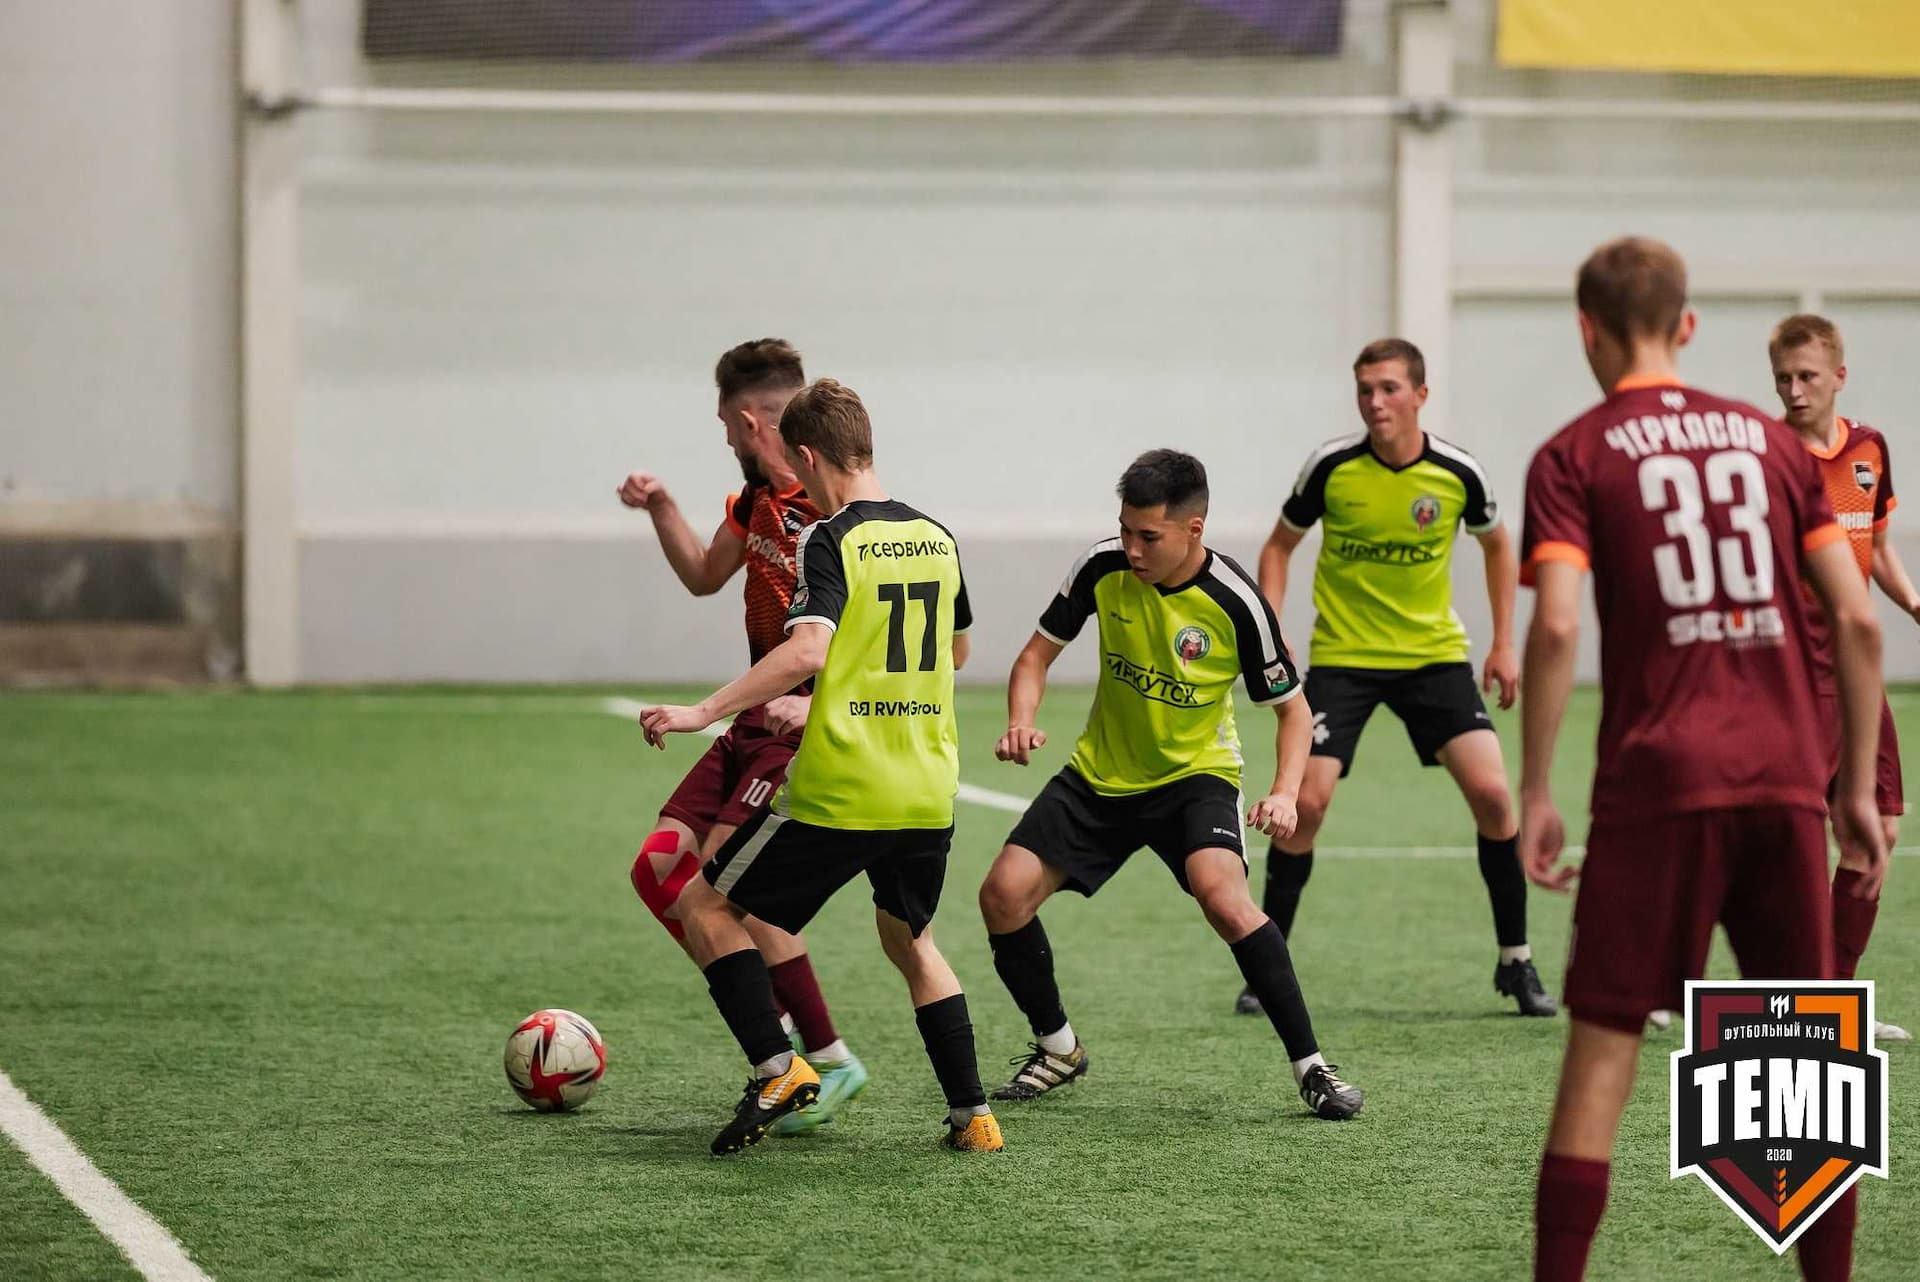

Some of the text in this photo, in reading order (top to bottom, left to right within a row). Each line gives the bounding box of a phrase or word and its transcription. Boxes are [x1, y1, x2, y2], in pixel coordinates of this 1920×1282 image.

[1604, 411, 1767, 460] ЧЕРКАСОВ
[1637, 449, 1774, 608] 33
[872, 540, 949, 559] сервико
[741, 778, 772, 807] 10
